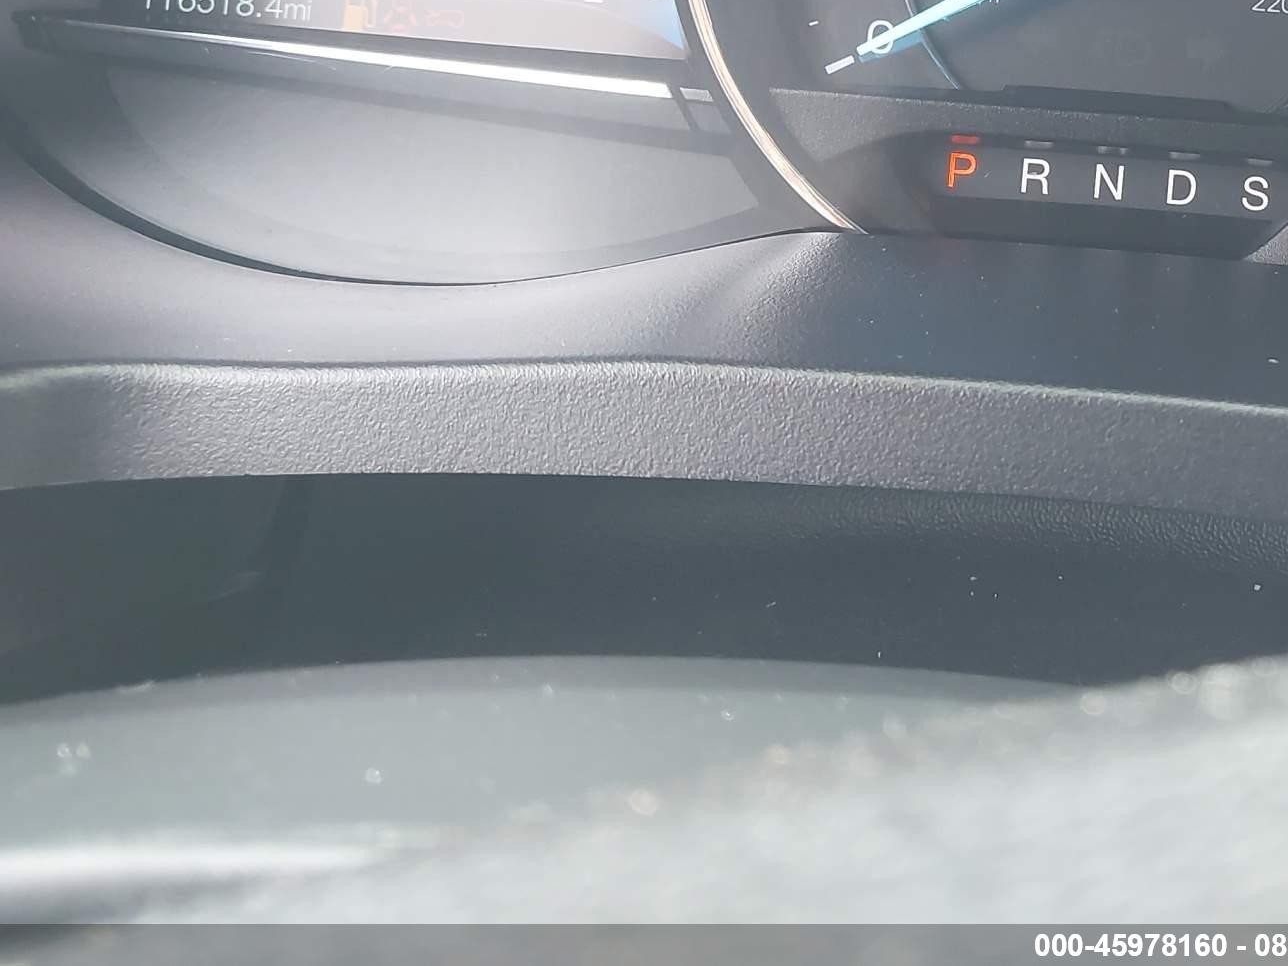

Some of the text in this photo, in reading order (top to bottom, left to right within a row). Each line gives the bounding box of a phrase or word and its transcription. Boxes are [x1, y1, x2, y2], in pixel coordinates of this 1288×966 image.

[867, 20, 894, 54] 0
[946, 152, 1269, 212] P R N D S
